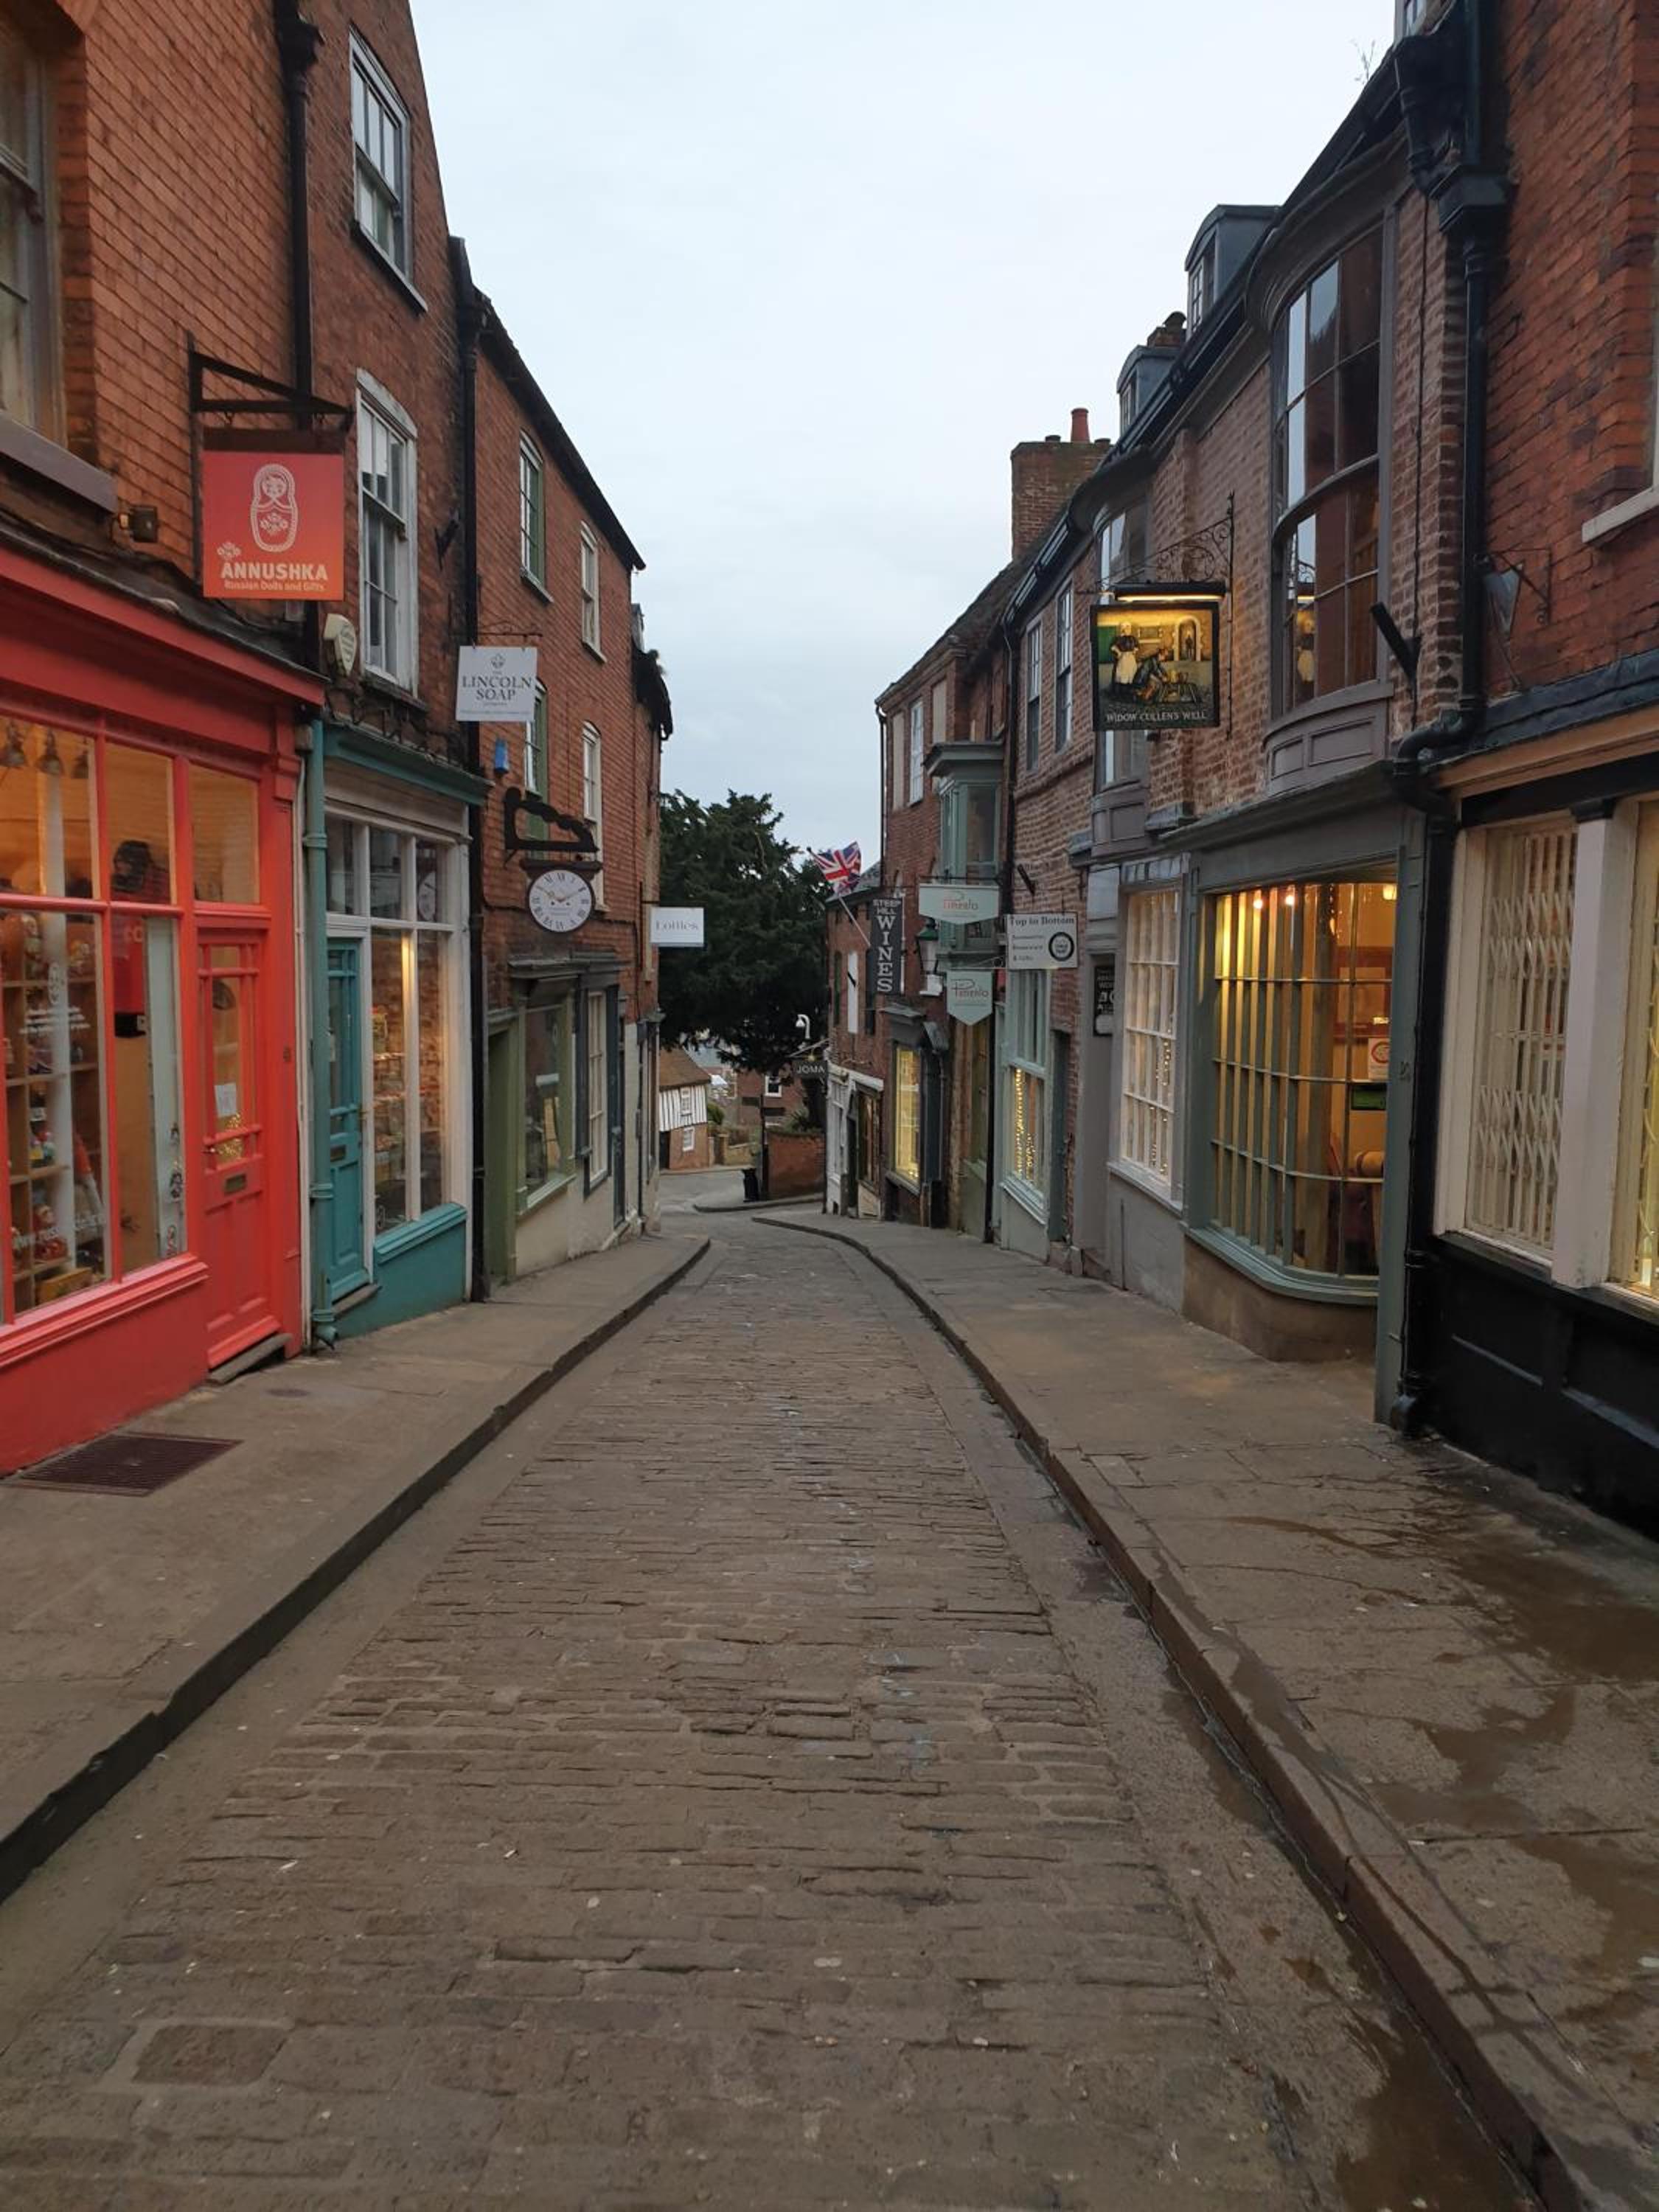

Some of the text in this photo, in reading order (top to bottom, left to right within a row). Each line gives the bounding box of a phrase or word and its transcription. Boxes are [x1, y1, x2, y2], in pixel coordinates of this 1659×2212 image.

[221, 562, 327, 580] ANNUSHKA
[462, 675, 532, 687] LINCOLN
[476, 689, 515, 700] SOAP
[1107, 712, 1136, 722] WIDOW
[1183, 710, 1206, 720] WELL
[1010, 917, 1027, 927] Top
[875, 915, 897, 992] WINES
